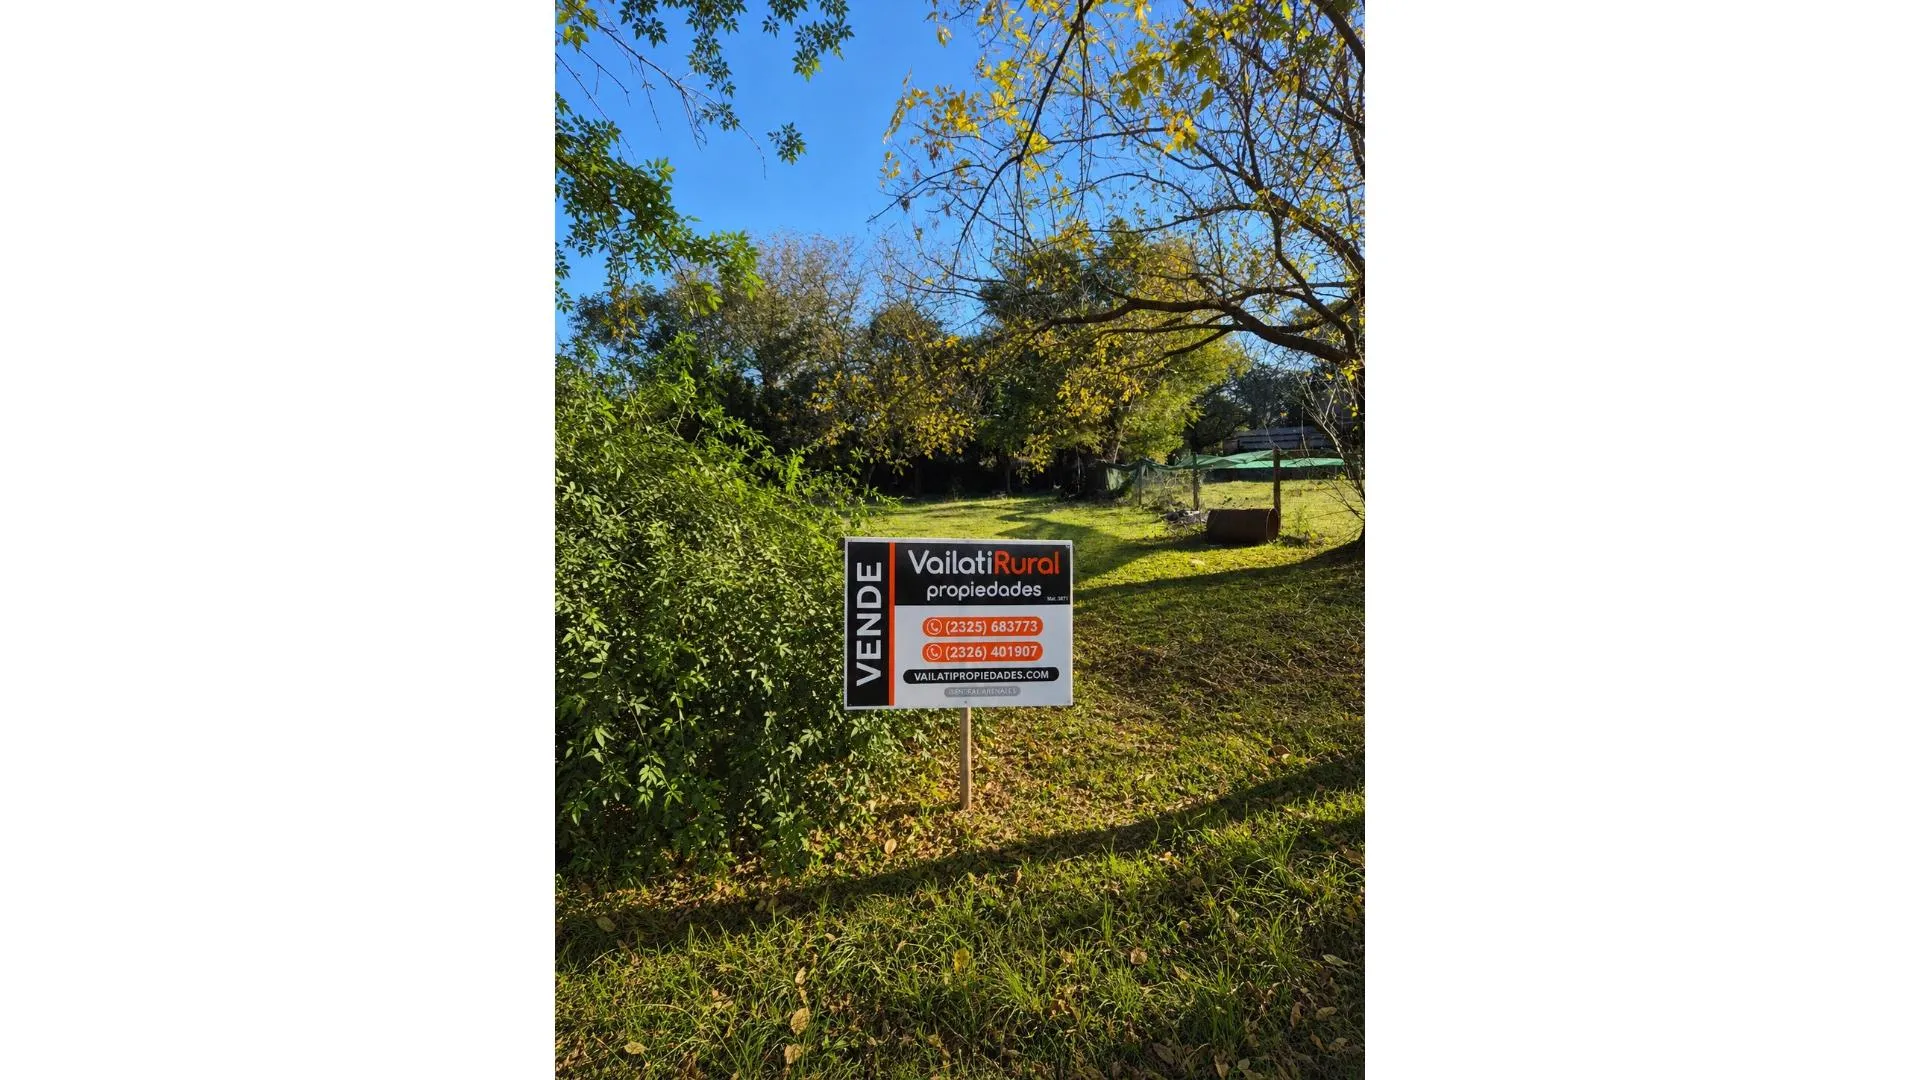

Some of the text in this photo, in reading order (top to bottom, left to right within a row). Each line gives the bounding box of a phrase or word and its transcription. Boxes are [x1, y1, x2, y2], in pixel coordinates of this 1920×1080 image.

[908, 550, 1060, 576] VailatiRural
[927, 581, 1042, 601] propiedades
[856, 562, 882, 687] VENDE
[946, 620, 1038, 635] (2325) 683773
[946, 646, 1038, 660] (2326) 401907
[914, 670, 1049, 682] VAILATIPROPIEDADES.COM
